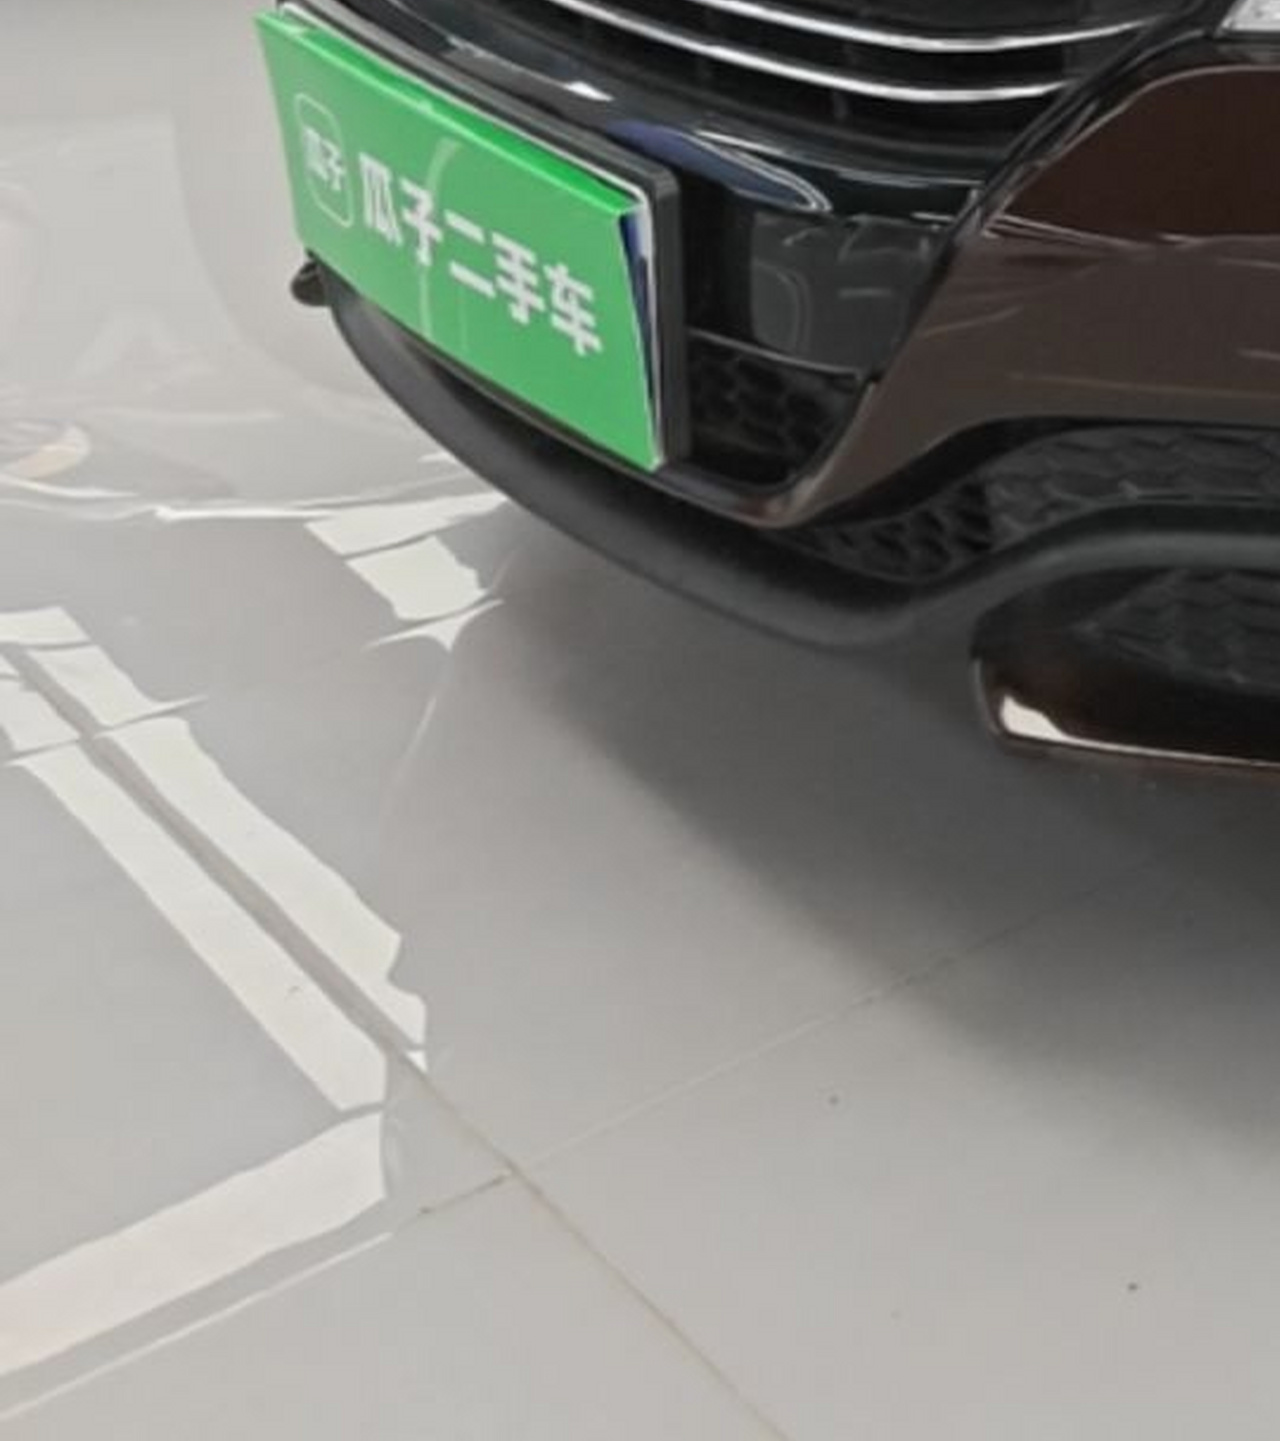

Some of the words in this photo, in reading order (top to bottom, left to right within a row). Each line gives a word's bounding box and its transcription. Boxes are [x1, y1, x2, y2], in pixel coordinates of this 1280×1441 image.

[358, 150, 602, 357] 瓜子二手车
